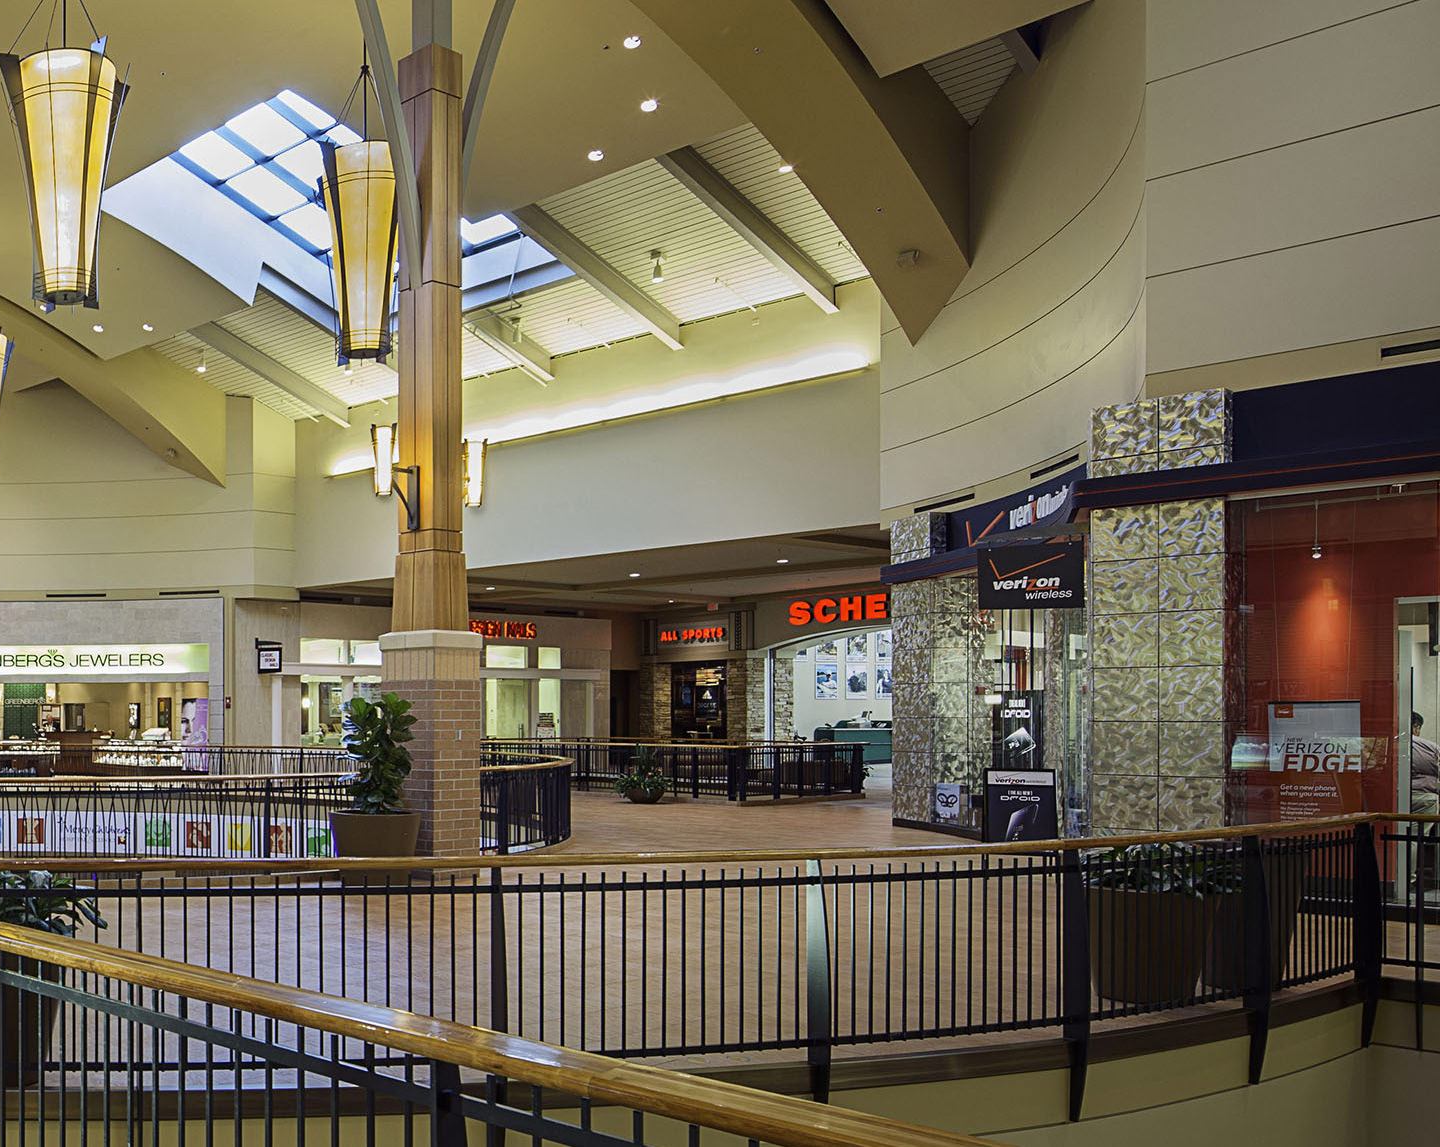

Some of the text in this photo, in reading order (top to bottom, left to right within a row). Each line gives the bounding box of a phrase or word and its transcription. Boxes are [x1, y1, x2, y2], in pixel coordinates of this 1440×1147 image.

[993, 576, 1061, 591] verizon
[1025, 589, 1073, 600] wireless
[661, 627, 724, 642] ALL SPORTS
[69, 653, 165, 667] JEWELERS
[1275, 743, 1348, 754] VERIZON
[1283, 754, 1362, 773] EDGE
[1315, 785, 1336, 793] phone
